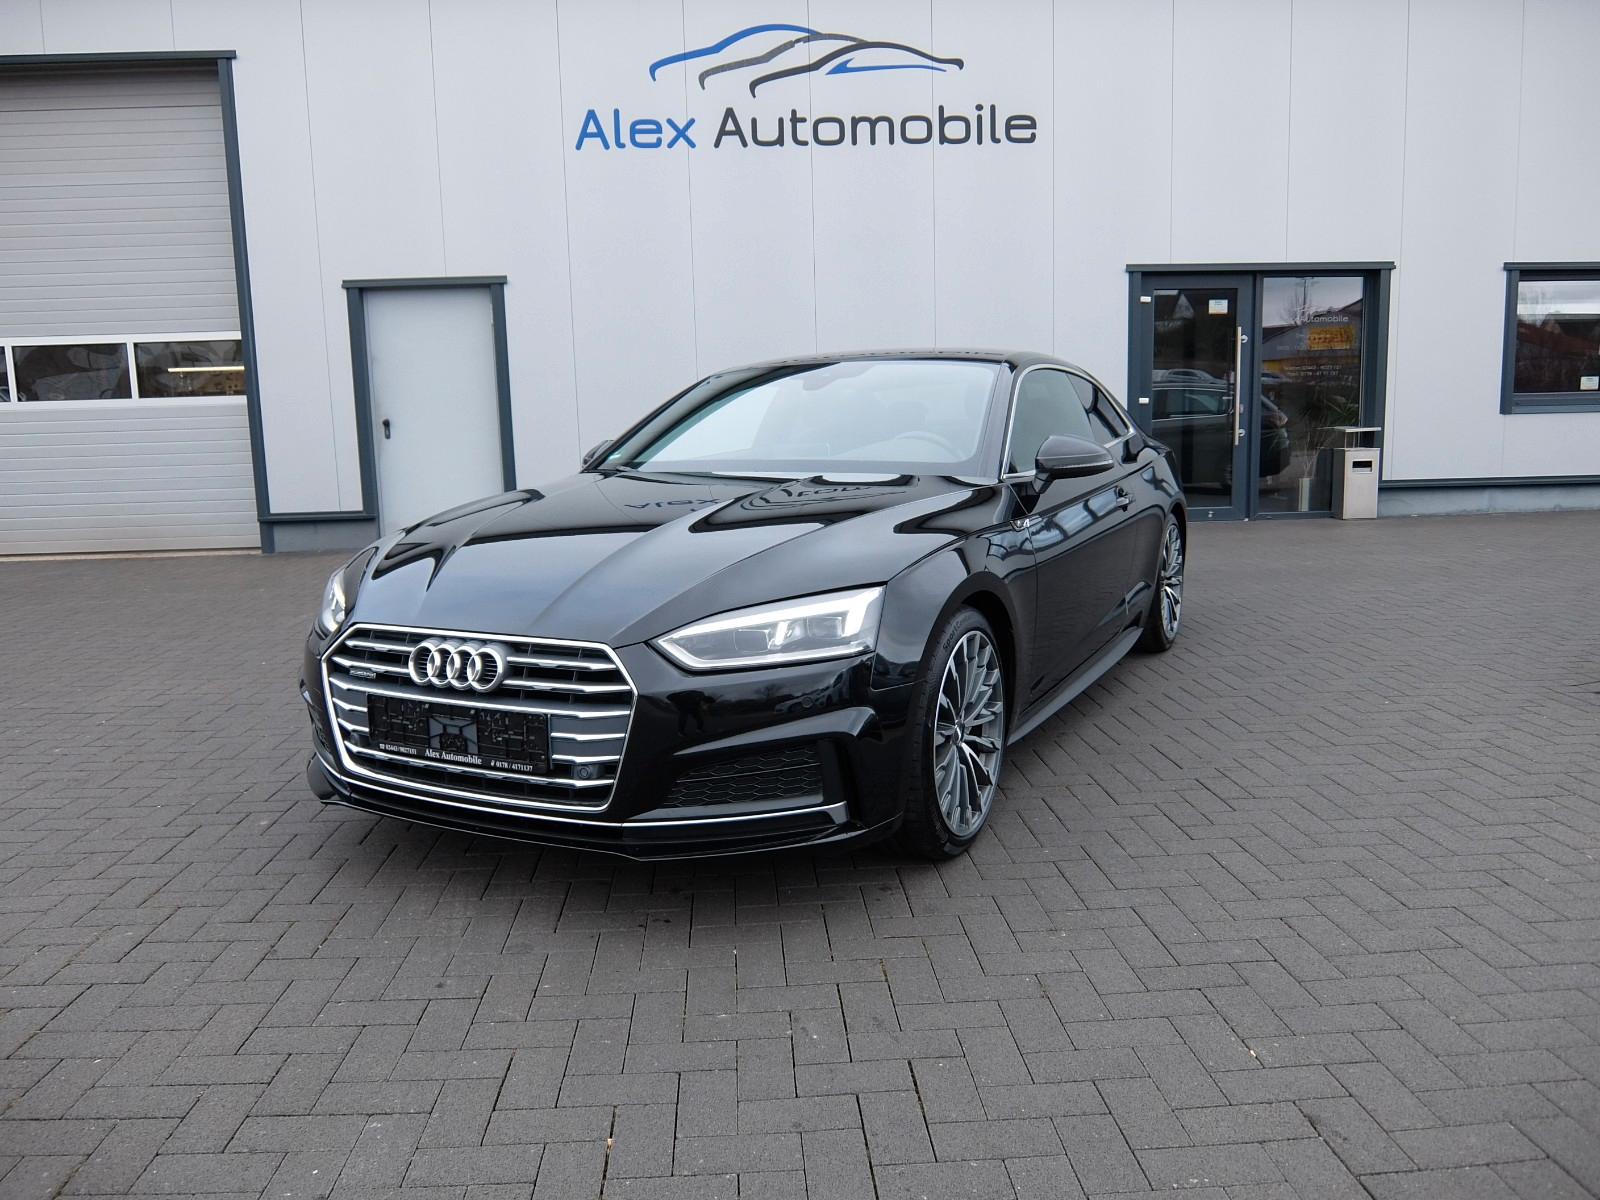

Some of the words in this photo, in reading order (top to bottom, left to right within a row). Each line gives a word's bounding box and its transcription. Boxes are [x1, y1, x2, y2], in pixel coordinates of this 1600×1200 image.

[576, 108, 696, 151] Alex
[714, 104, 1037, 148] Automobile
[425, 748, 440, 758] Alex
[441, 751, 483, 765] Automobile
